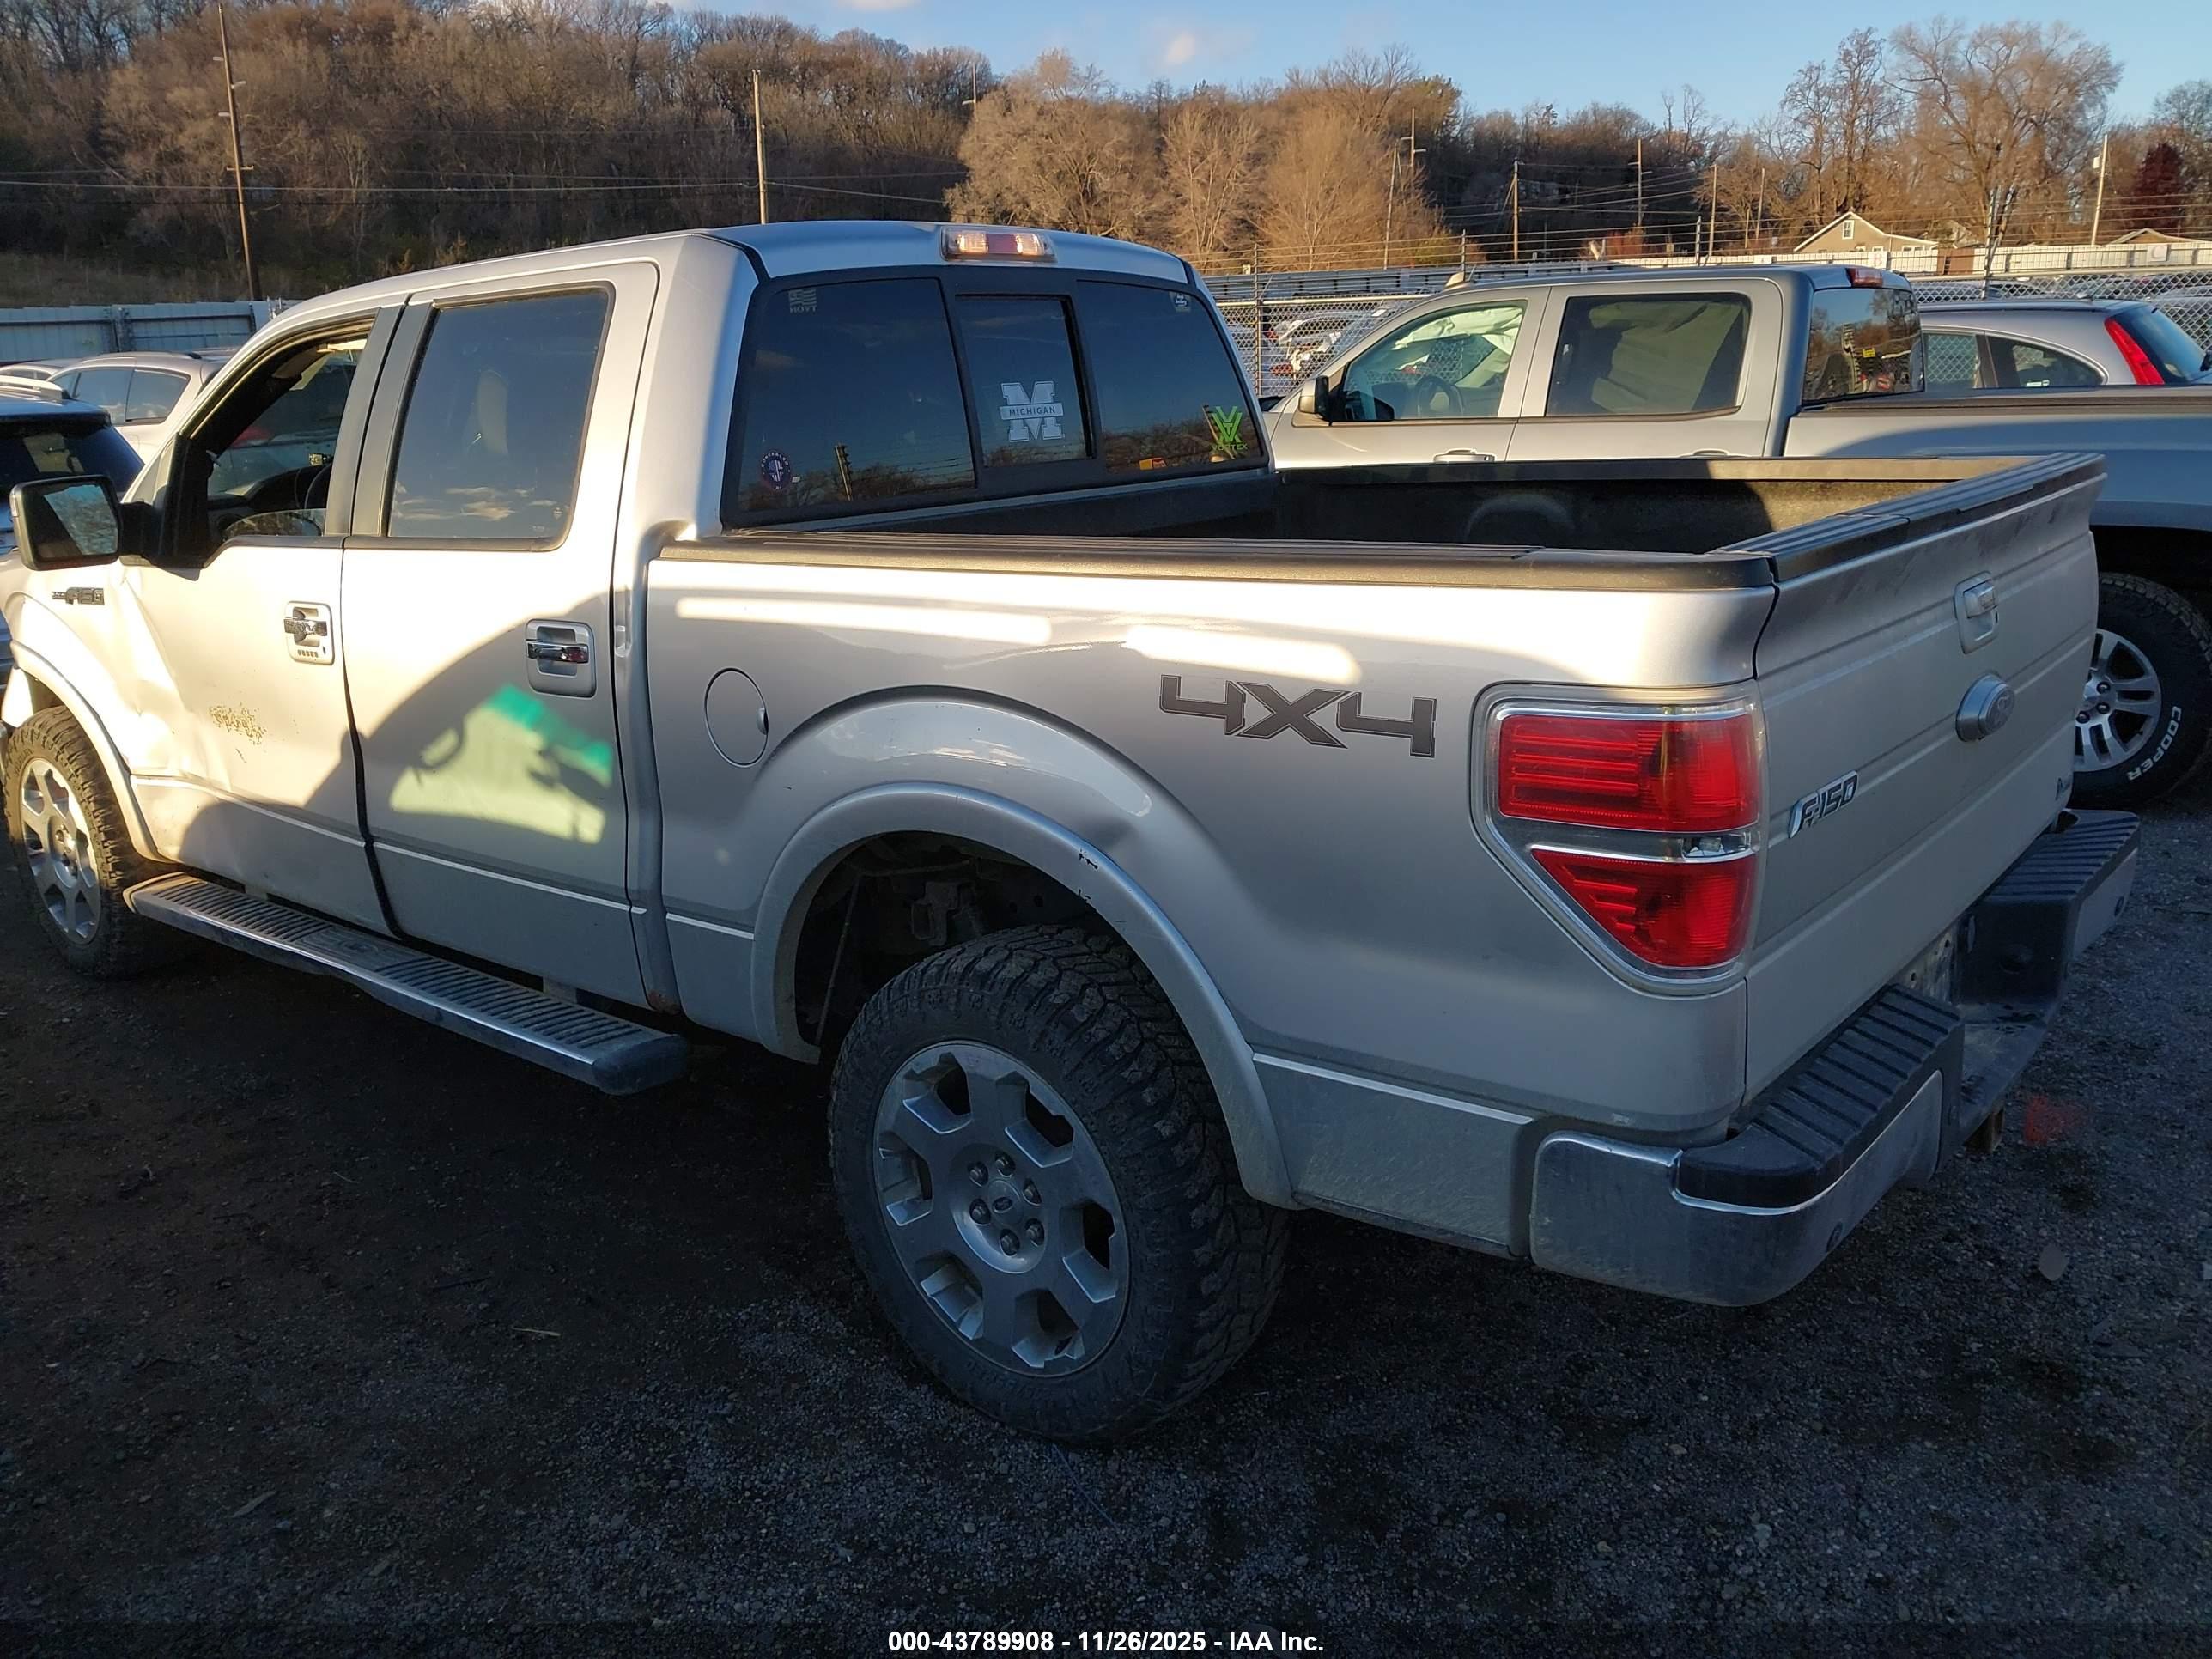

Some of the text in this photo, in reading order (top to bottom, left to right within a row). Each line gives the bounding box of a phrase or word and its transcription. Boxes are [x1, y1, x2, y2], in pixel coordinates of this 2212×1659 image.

[1009, 405, 1056, 416] MICHIGAN
[1159, 674, 1437, 758] 4X4
[2125, 704, 2183, 782] COOPER
